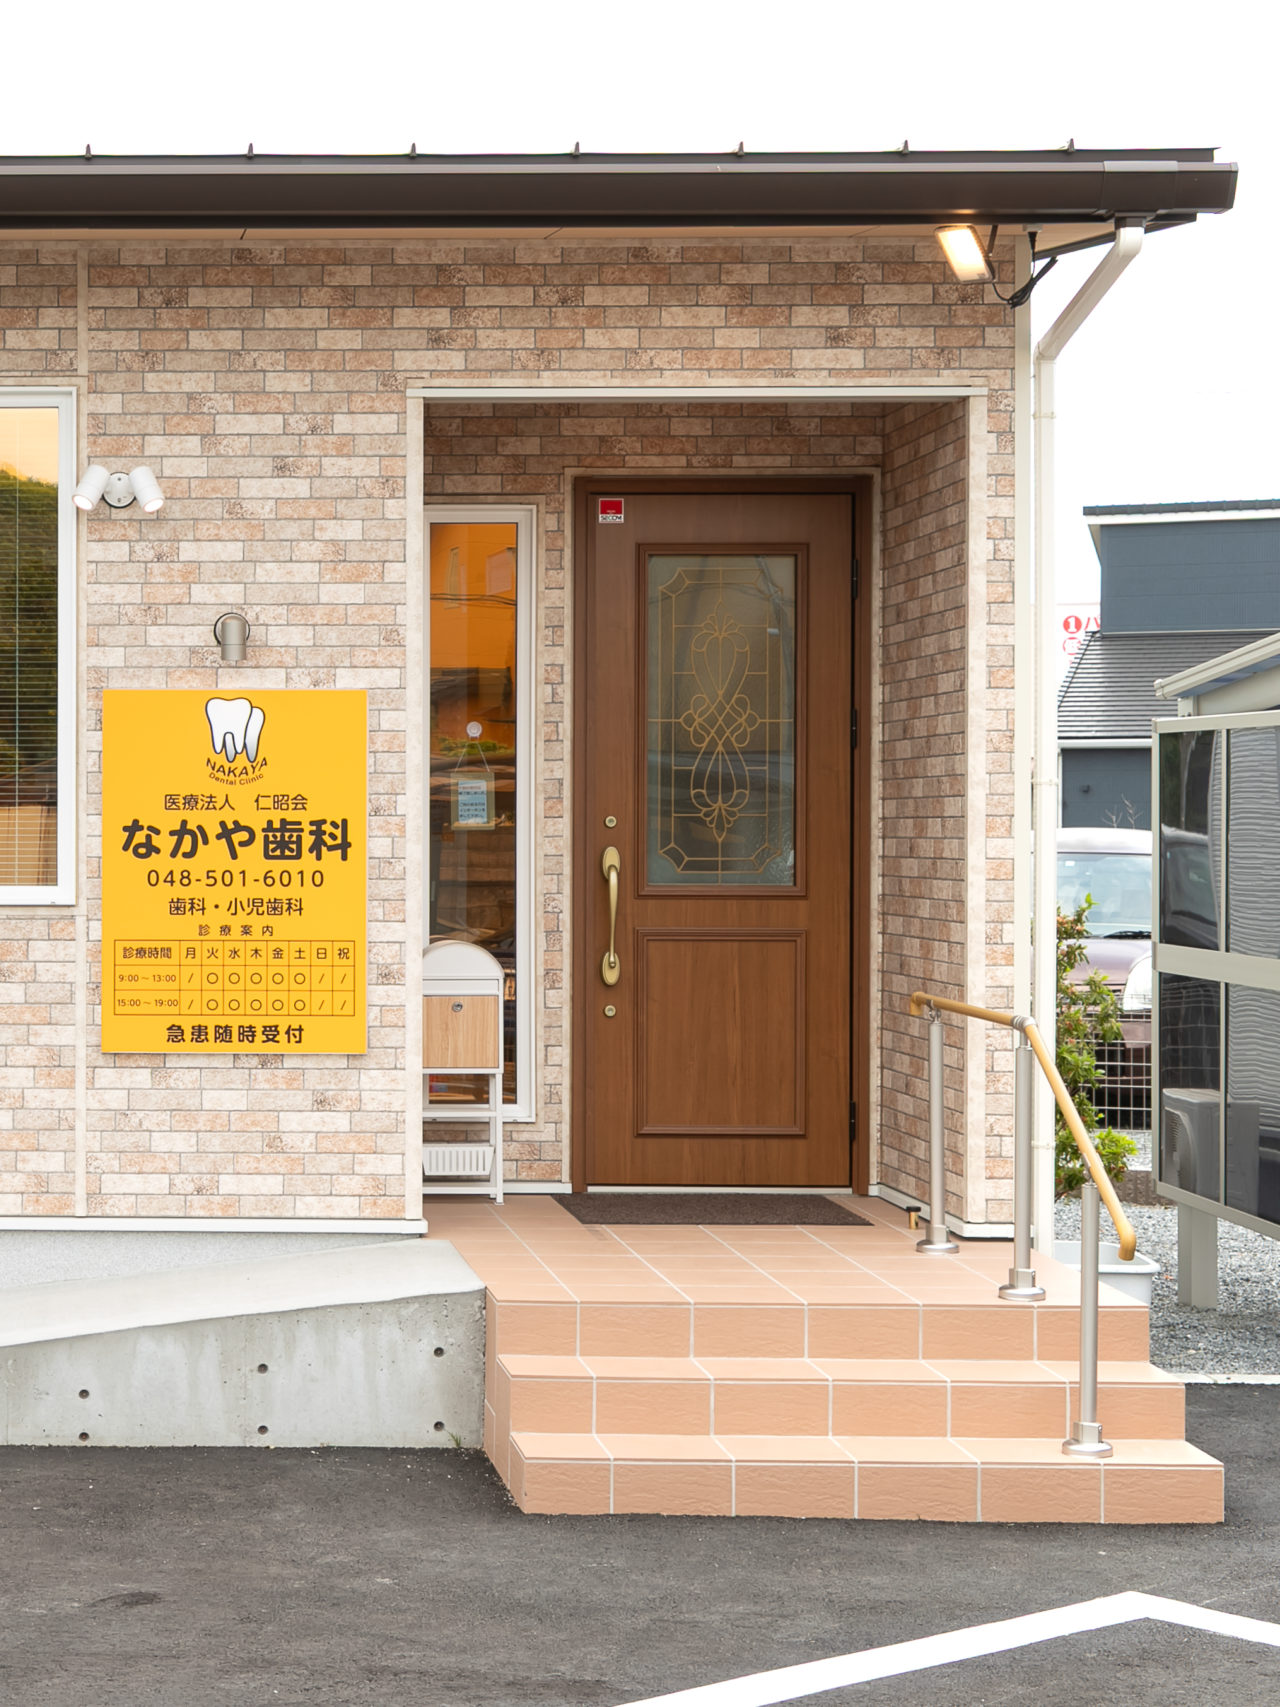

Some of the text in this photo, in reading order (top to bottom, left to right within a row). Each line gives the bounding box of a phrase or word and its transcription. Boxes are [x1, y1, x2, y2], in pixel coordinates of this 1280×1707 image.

[206, 757, 267, 778] NAKAYA
[209, 772, 264, 785] Dental Clinic
[164, 794, 308, 811] 医療法人 仁昭会
[122, 818, 351, 861] なかや歯科
[147, 870, 324, 887] 048-501-6010
[169, 898, 304, 916] 歯科・小児歯科
[198, 924, 274, 937] 診療案内
[123, 946, 350, 959] 診療時間 月 火 水 木 金 土 日 祝
[166, 1024, 304, 1044] 急患随時受付
